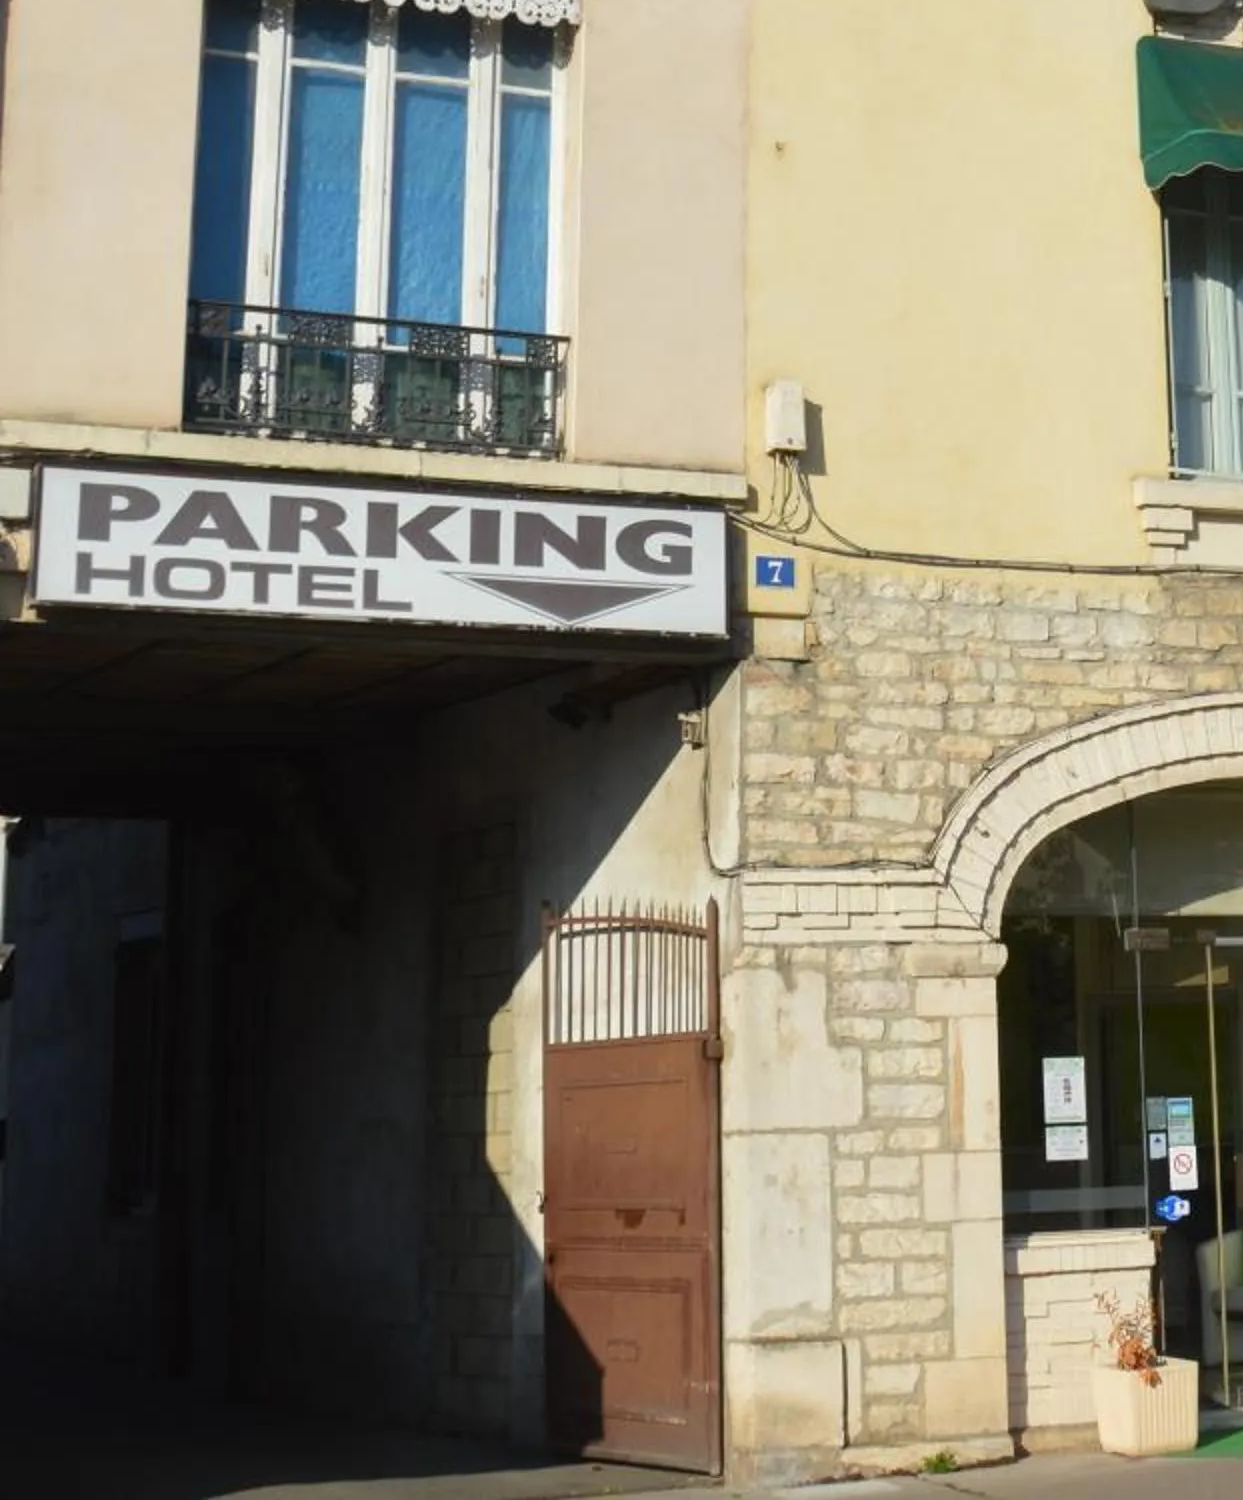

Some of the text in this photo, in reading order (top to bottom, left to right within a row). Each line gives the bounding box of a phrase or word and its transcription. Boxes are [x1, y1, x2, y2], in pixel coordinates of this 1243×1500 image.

[75, 481, 694, 576] PARKING
[73, 551, 413, 613] HOTEL
[767, 560, 784, 584] 7
